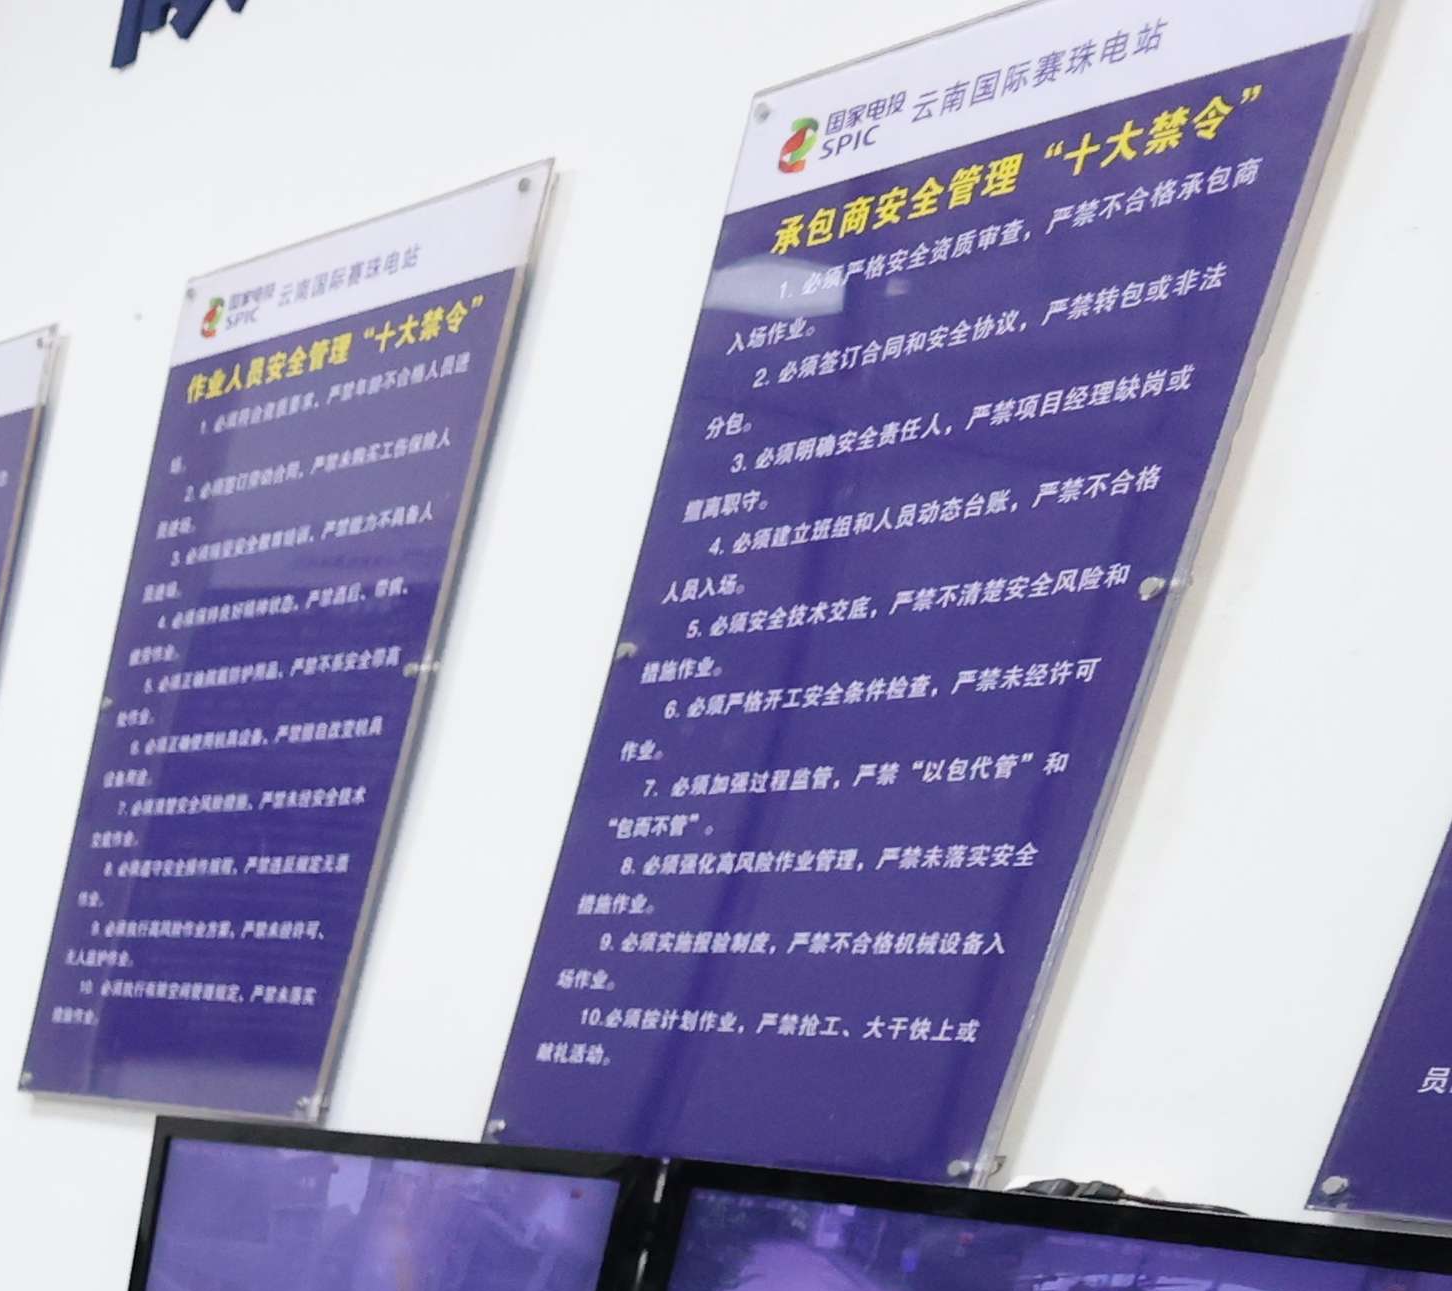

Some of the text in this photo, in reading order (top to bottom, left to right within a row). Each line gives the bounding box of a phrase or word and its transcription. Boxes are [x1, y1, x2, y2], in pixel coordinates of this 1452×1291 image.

[825, 18, 1169, 136] 国家电投 云南国际赛珠电站
[819, 123, 880, 161] SPIC
